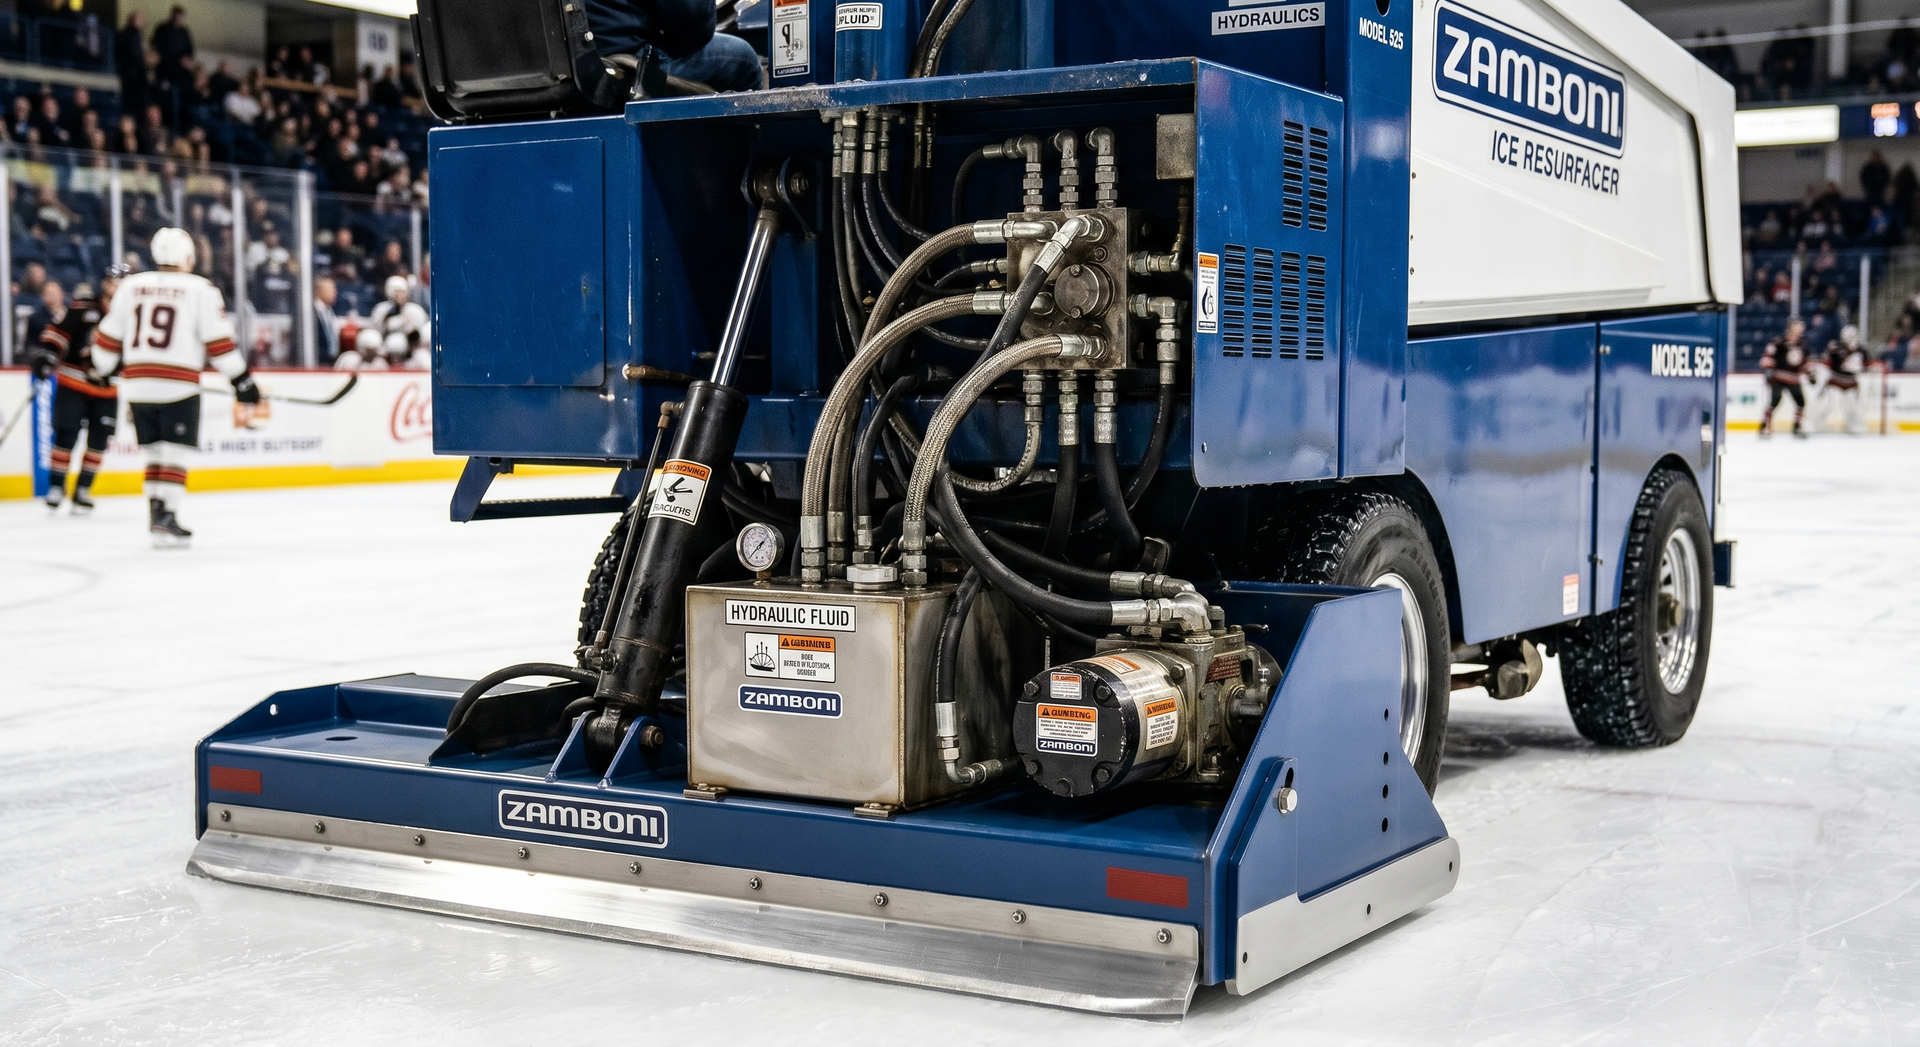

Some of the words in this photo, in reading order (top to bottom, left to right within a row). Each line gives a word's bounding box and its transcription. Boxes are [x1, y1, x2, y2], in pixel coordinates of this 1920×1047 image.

[1218, 7, 1320, 30] HYDRAULICS
[1359, 17, 1388, 45] MODEL
[1389, 29, 1404, 50] 525
[1443, 24, 1619, 137] ZAMBONI
[1491, 130, 1519, 167] ICE
[1523, 140, 1620, 196] RESURFACER
[132, 302, 176, 349] 19
[1651, 343, 1693, 377] MODEL
[1694, 346, 1714, 378] 525
[731, 604, 806, 624] HYDRAULIC
[811, 608, 849, 627] FLUID
[744, 691, 837, 712] ZAMBONI
[1039, 740, 1093, 753] ZAMBONI
[506, 800, 659, 838] ZAMBONI
